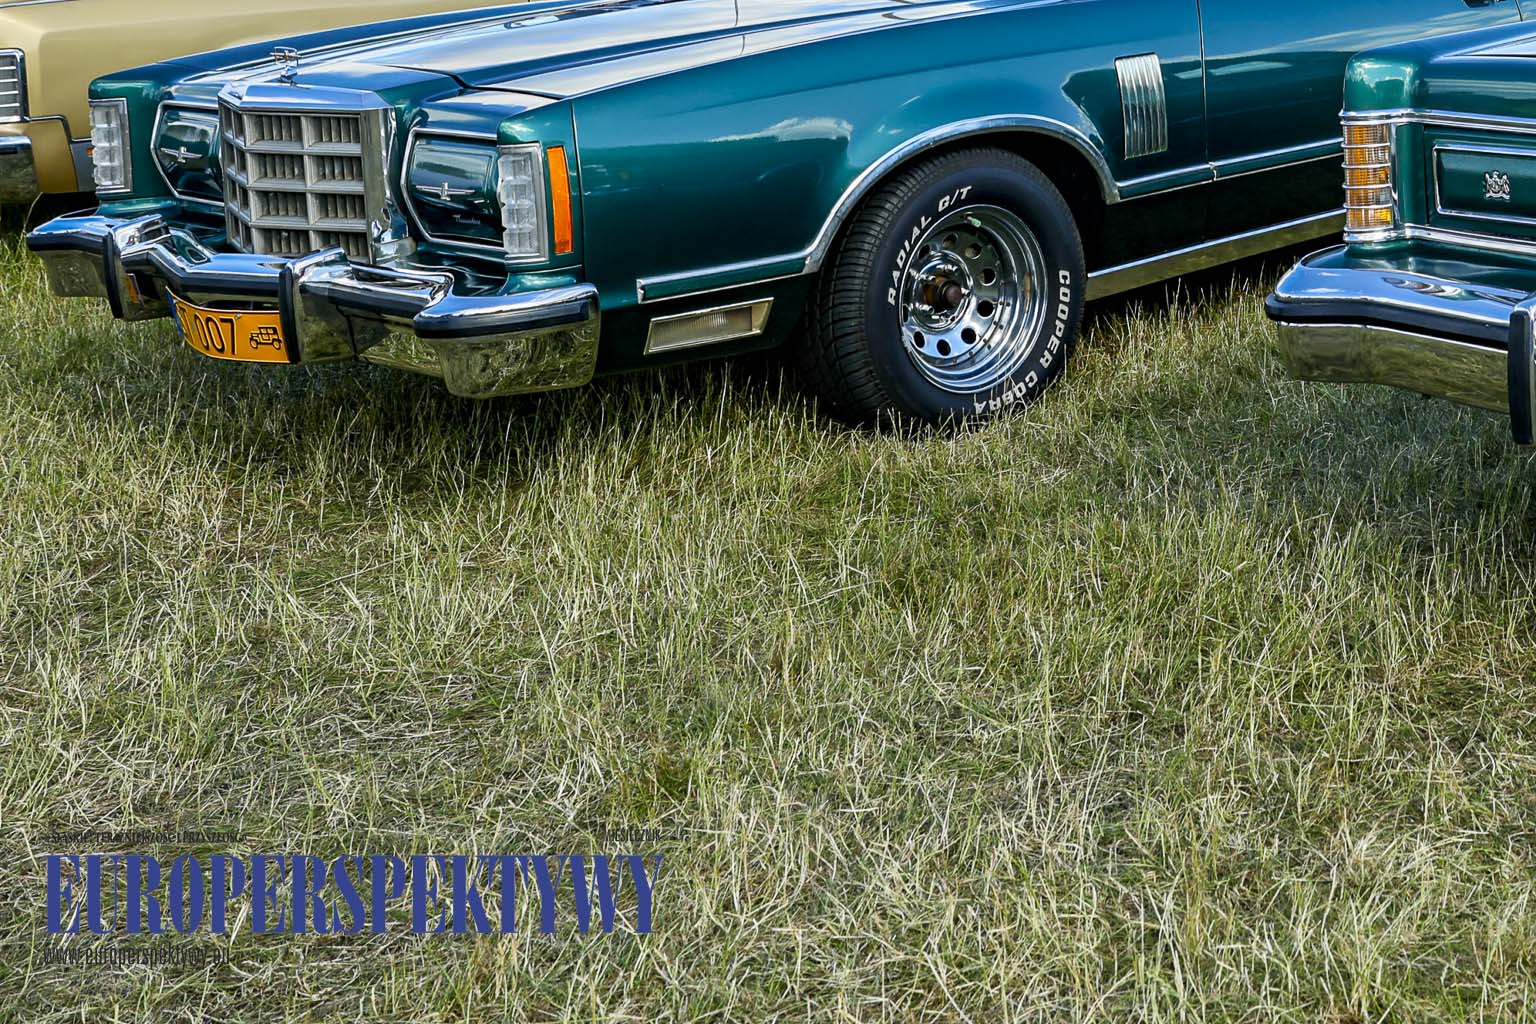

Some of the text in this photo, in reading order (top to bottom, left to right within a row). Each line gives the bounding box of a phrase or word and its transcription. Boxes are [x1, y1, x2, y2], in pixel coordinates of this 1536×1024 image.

[887, 185, 972, 306] RADIAL G/T
[194, 313, 237, 355] 007
[974, 269, 1071, 415] COOPER COBRA
